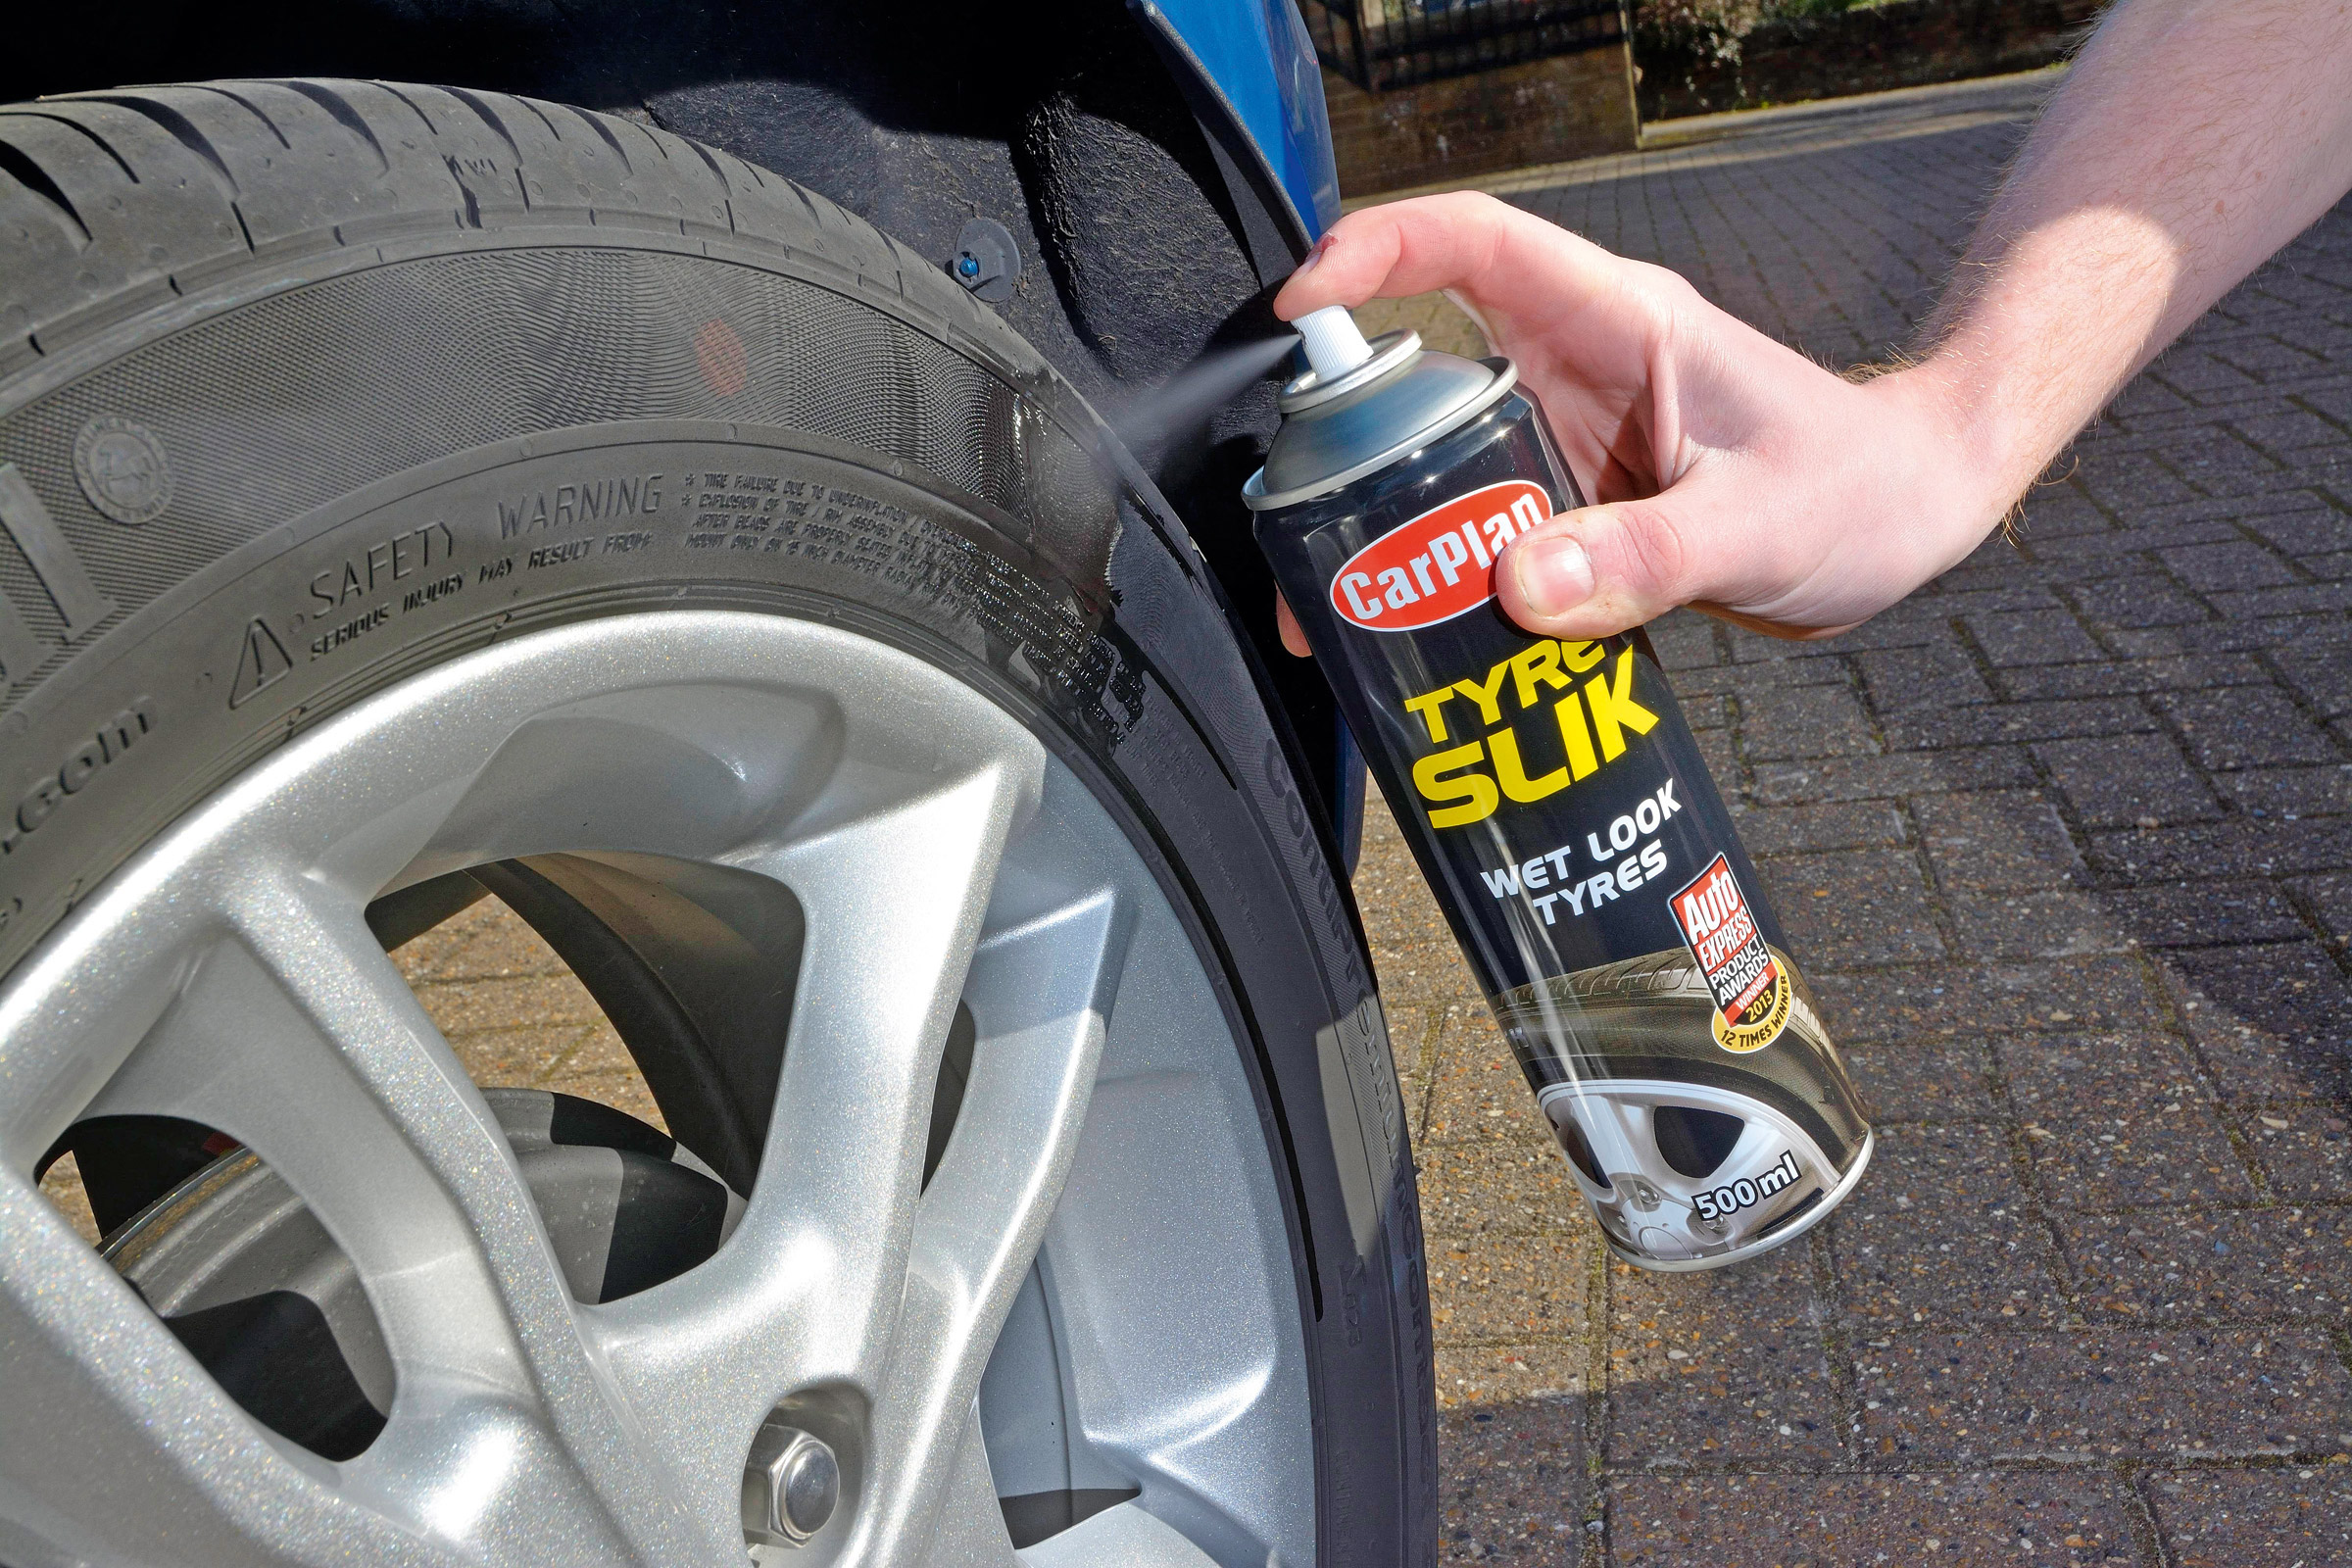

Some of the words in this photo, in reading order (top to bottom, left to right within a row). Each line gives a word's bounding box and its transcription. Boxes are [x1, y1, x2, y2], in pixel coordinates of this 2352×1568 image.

[692, 512, 730, 528] AFTER
[705, 472, 728, 488] TIRE
[734, 474, 779, 493] FAILURE
[783, 479, 806, 496] DUE
[811, 483, 824, 501] TO
[310, 519, 454, 620] SAFETY
[497, 472, 664, 539] WARNING
[1340, 492, 1547, 620] CarPlan
[310, 601, 390, 662] SERIOUS
[403, 571, 465, 614] INJURY
[478, 556, 514, 585] MAY
[527, 536, 595, 570] RESULT
[1404, 639, 1605, 743] TYRE
[1412, 644, 1659, 829] SLIK
[1480, 845, 1571, 899] WET
[1587, 777, 1682, 862] LOOK
[1532, 839, 1667, 925] TYRES
[1698, 909, 1752, 973] EXPRESS
[1708, 933, 1761, 990] PRODUCT
[1719, 948, 1769, 1006] AWARDS
[1721, 1029, 1737, 1047] 12
[1739, 1026, 1773, 1048] TIMES
[1772, 974, 1788, 1029] WINNER
[1735, 972, 1770, 1010] WINNER
[1744, 990, 1774, 1023] 2013
[1692, 1179, 1757, 1220] 500
[1756, 1151, 1801, 1199] ml
